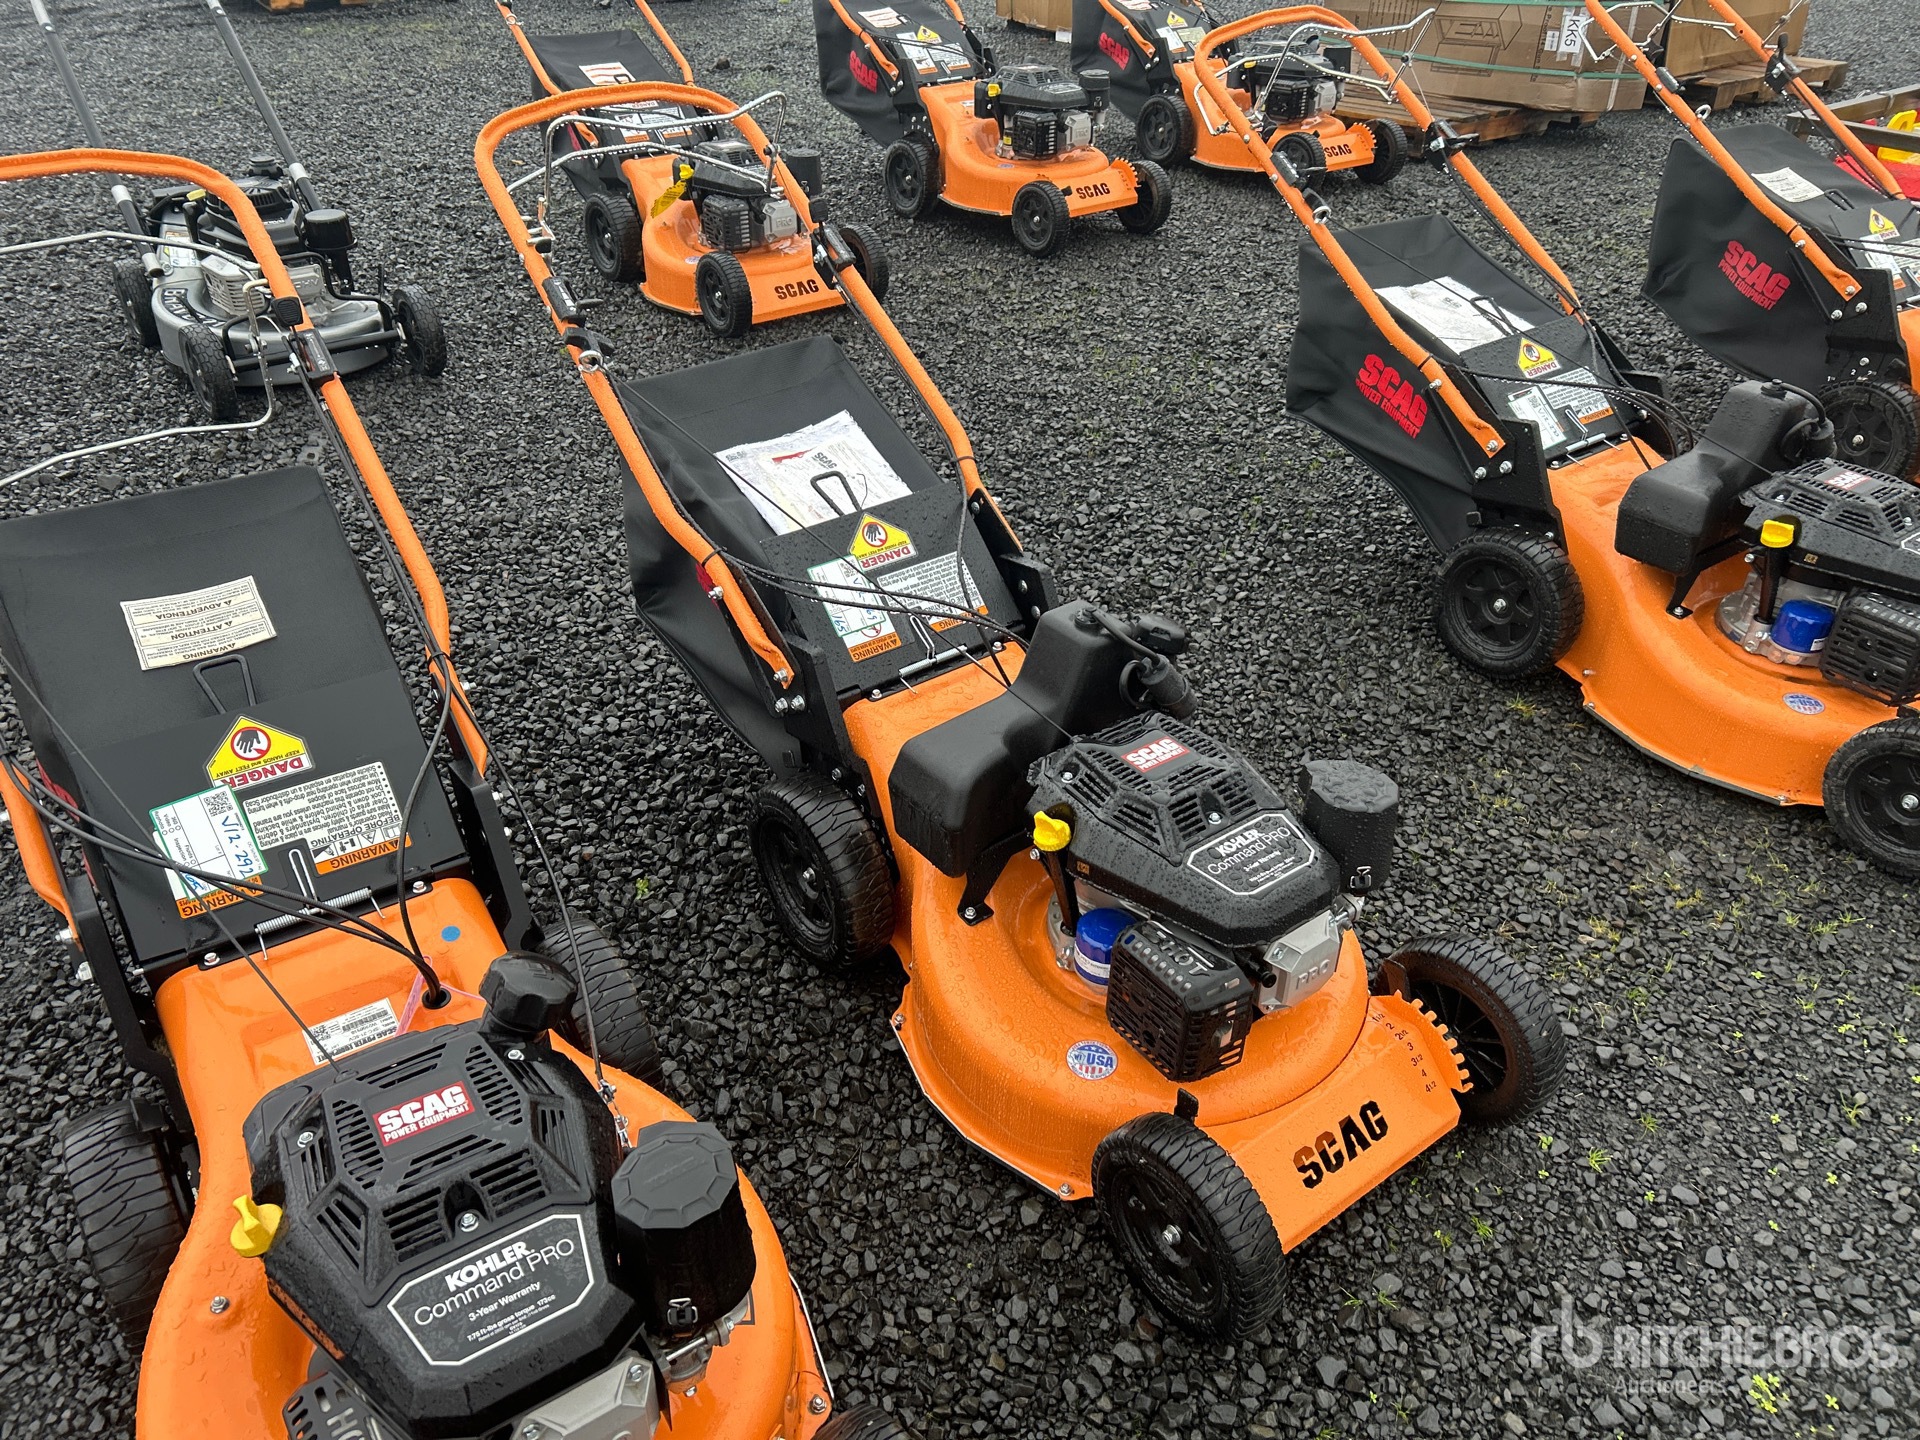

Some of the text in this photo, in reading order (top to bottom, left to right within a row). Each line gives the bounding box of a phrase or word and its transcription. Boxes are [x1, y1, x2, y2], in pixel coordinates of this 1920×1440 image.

[1564, 19, 1580, 47] KK5
[849, 50, 878, 87] SCAG
[1324, 143, 1352, 158] SCAG
[1076, 182, 1110, 200] SCAG
[776, 216, 793, 228] PRO
[1724, 240, 1790, 300] SCAG
[774, 279, 820, 300] SCAG
[1718, 258, 1776, 310] POWER EQUIPMENT
[1526, 362, 1557, 377] DANGER
[1358, 354, 1428, 427] SCAG
[1356, 378, 1421, 438] POWER EQUIPMENT
[814, 452, 838, 470] SCAG
[861, 546, 911, 569] DANGER
[156, 602, 222, 621] ADVERTENCIA
[833, 613, 849, 634] 165
[171, 624, 223, 641] ATTENTION
[182, 645, 228, 660] WARNING
[853, 641, 891, 661] WARNING
[284, 749, 300, 757] KEEP
[1126, 738, 1180, 766] SCAG
[263, 754, 283, 764] HANDS
[215, 768, 234, 778] AWAY
[234, 764, 250, 772] FEET
[359, 765, 376, 776] Solicite
[332, 770, 359, 783] etiquetas
[352, 774, 369, 784] caution
[369, 771, 378, 779] Use
[303, 780, 324, 792] español
[339, 779, 351, 788] when
[348, 782, 367, 792] across
[367, 778, 381, 787] Mow
[290, 787, 298, 795] un
[305, 789, 316, 798] near
[316, 783, 339, 795] operating
[334, 787, 347, 796] face
[345, 789, 366, 800] operate
[283, 792, 305, 804] drop-offs
[308, 793, 326, 804] slopes
[334, 795, 345, 804] this
[353, 795, 370, 805] down
[370, 791, 385, 800] Look
[244, 798, 260, 808] Scag
[265, 800, 278, 810] when
[312, 798, 334, 810] machine
[325, 802, 346, 813] behind
[357, 802, 371, 811] area
[371, 797, 388, 807] Clear
[378, 803, 391, 812] Make
[247, 804, 265, 815] turning
[282, 810, 293, 819] you
[294, 805, 311, 816] unless
[304, 808, 324, 820] before
[322, 809, 348, 822] children,
[349, 806, 356, 814] of
[350, 810, 366, 820] guards
[367, 807, 377, 815] sure
[163, 814, 172, 827] Video
[252, 816, 272, 828] trained
[273, 814, 282, 822] are
[281, 816, 297, 827] while
[298, 814, 304, 822] &
[327, 809, 393, 834] Read operator's manual
[331, 816, 345, 826] safety
[254, 821, 280, 835] backing
[285, 817, 320, 833] bystanders
[304, 826, 312, 834] are
[311, 814, 400, 847] BEFORE OPERATING
[312, 821, 331, 832] devices
[257, 830, 278, 841] debris
[284, 831, 298, 840] place
[220, 814, 256, 878] V12-292
[260, 836, 280, 848] working
[174, 838, 187, 861] Inspection
[184, 844, 194, 858] Fluids
[1207, 838, 1266, 877] Command
[1262, 824, 1291, 847] PRO
[330, 844, 389, 868] WARNING
[1298, 959, 1331, 991] PRO
[1386, 1022, 1394, 1030] 2
[353, 1034, 376, 1048] POWER
[1407, 1042, 1414, 1051] 3
[1087, 1052, 1114, 1068] USA
[1422, 1068, 1427, 1077] 4
[377, 1084, 466, 1134] SCAG
[384, 1103, 470, 1142] POWER EQUIPMENT
[1293, 1100, 1388, 1189] SCAG
[412, 1236, 576, 1328] Command PRO
[468, 1280, 542, 1322] 3-Year Warranty
[466, 1330, 481, 1342] 7.75
[479, 1322, 498, 1336] ft-lbs
[497, 1313, 516, 1328] gross
[514, 1303, 536, 1319] torque
